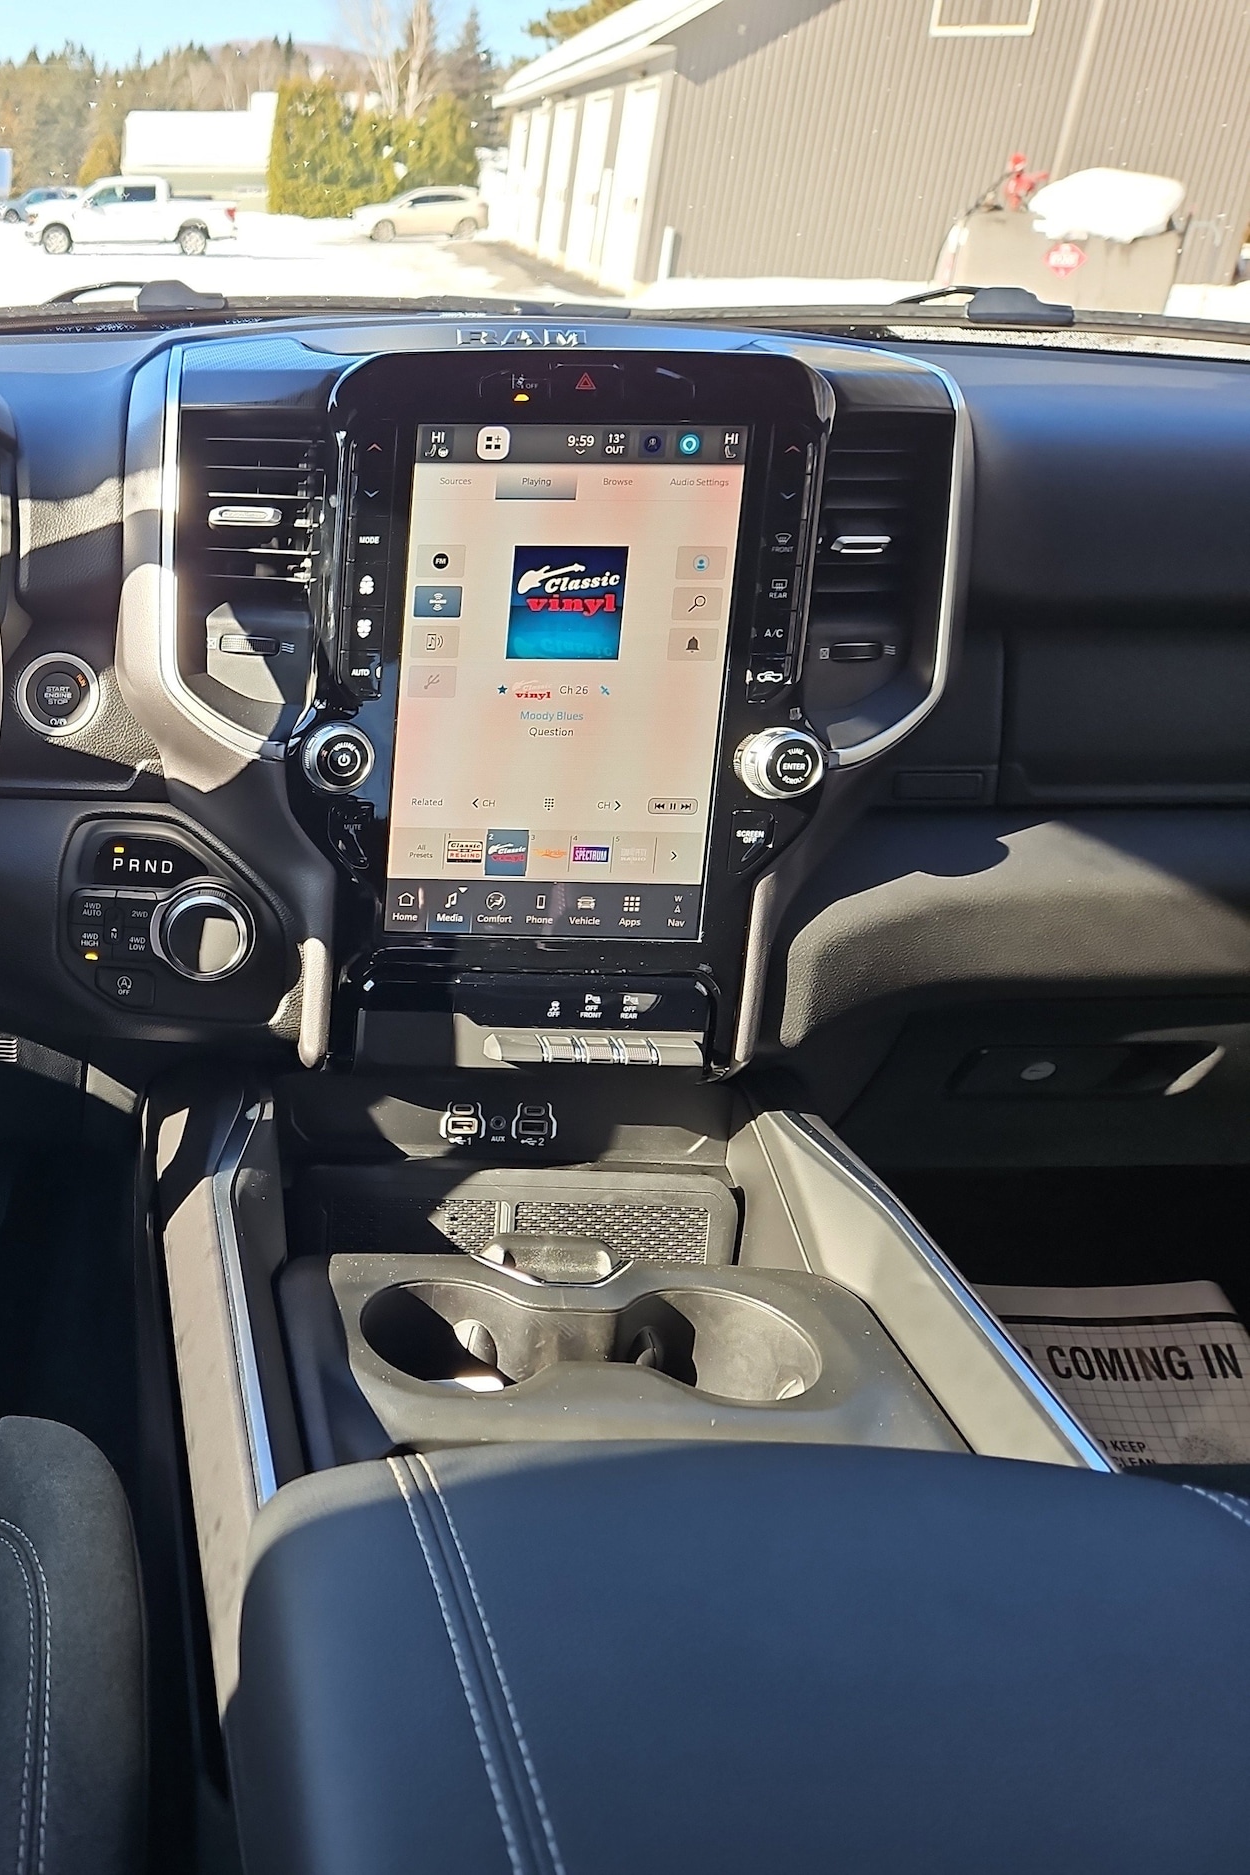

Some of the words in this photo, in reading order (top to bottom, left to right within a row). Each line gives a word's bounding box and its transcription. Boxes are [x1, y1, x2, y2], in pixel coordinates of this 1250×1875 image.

[455, 328, 587, 346] RAM
[431, 431, 445, 443] HI
[567, 435, 594, 447] 9:59
[607, 433, 625, 444] 13°
[725, 432, 739, 444] HI
[605, 445, 625, 455] OUT
[439, 477, 472, 486] Sources
[521, 477, 552, 487] Playing
[603, 477, 633, 486] Browse
[669, 478, 695, 487] Audio
[697, 478, 730, 488] Settings
[359, 536, 380, 544] MODE
[434, 557, 447, 565] FM
[544, 571, 621, 593] Classic
[768, 591, 788, 599] REAR
[526, 594, 617, 617] vinyl
[763, 628, 784, 638] A/C
[351, 669, 370, 677] AUTO
[559, 685, 574, 695] Ch
[575, 685, 589, 695] 26
[515, 691, 551, 701] vinyl
[520, 711, 555, 722] Moody
[556, 711, 584, 721] Blues
[528, 727, 575, 738] Question
[782, 762, 806, 770] ENTER
[411, 797, 443, 806] Related
[482, 799, 496, 808] CH
[597, 801, 611, 810] CH
[736, 830, 765, 839] SCREEN
[742, 836, 757, 844] OFF
[409, 851, 433, 860] Presets
[575, 848, 608, 861] SPECTRUM
[83, 902, 101, 910] 4WD
[82, 909, 102, 917] AUTO
[392, 912, 418, 922] Home
[436, 913, 463, 922] Media
[477, 914, 512, 925] Comfort
[526, 915, 553, 924] Phone
[569, 916, 601, 926] Vehicle
[618, 917, 641, 929] Apps
[667, 918, 685, 928] Nav
[81, 932, 99, 940] 4WD
[129, 936, 146, 944] 4WD
[80, 939, 99, 947] HIGH
[128, 943, 145, 951] LOW
[580, 1011, 602, 1019] FRONT
[1047, 1345, 1196, 1382] COMING
[1199, 1344, 1243, 1380] IN
[1110, 1440, 1146, 1454] KEEP
